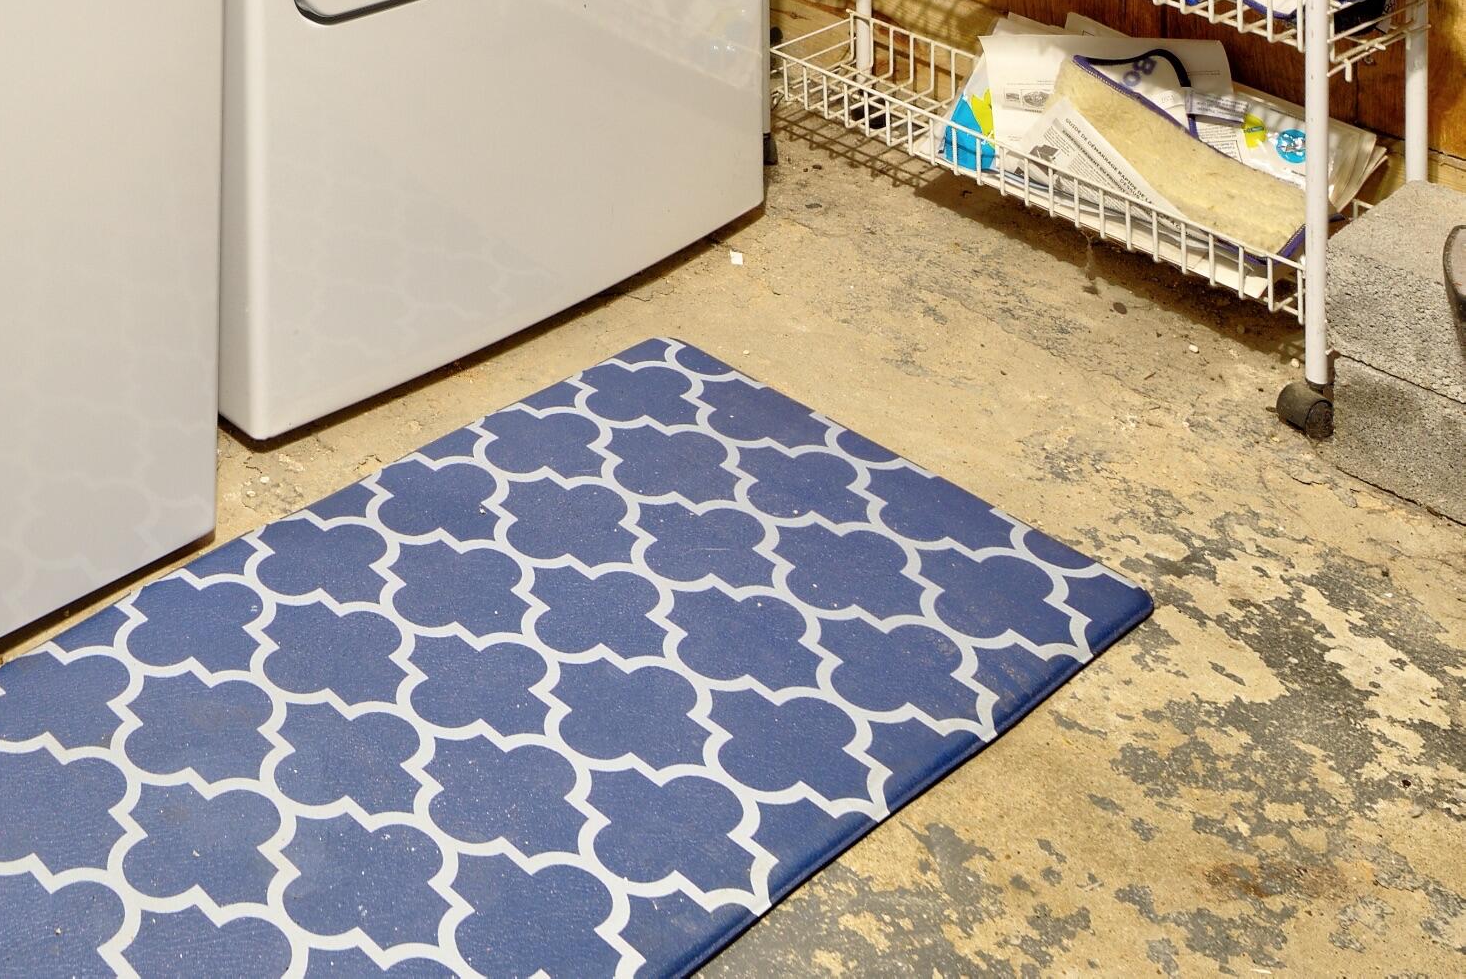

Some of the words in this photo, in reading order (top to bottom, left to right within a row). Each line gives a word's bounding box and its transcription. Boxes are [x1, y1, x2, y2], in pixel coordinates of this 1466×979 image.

[1065, 118, 1081, 134] GUIDE
[1080, 133, 1088, 141] DE
[1087, 140, 1117, 171] DÉMARRAGE
[1117, 170, 1137, 190] RAPIDE
